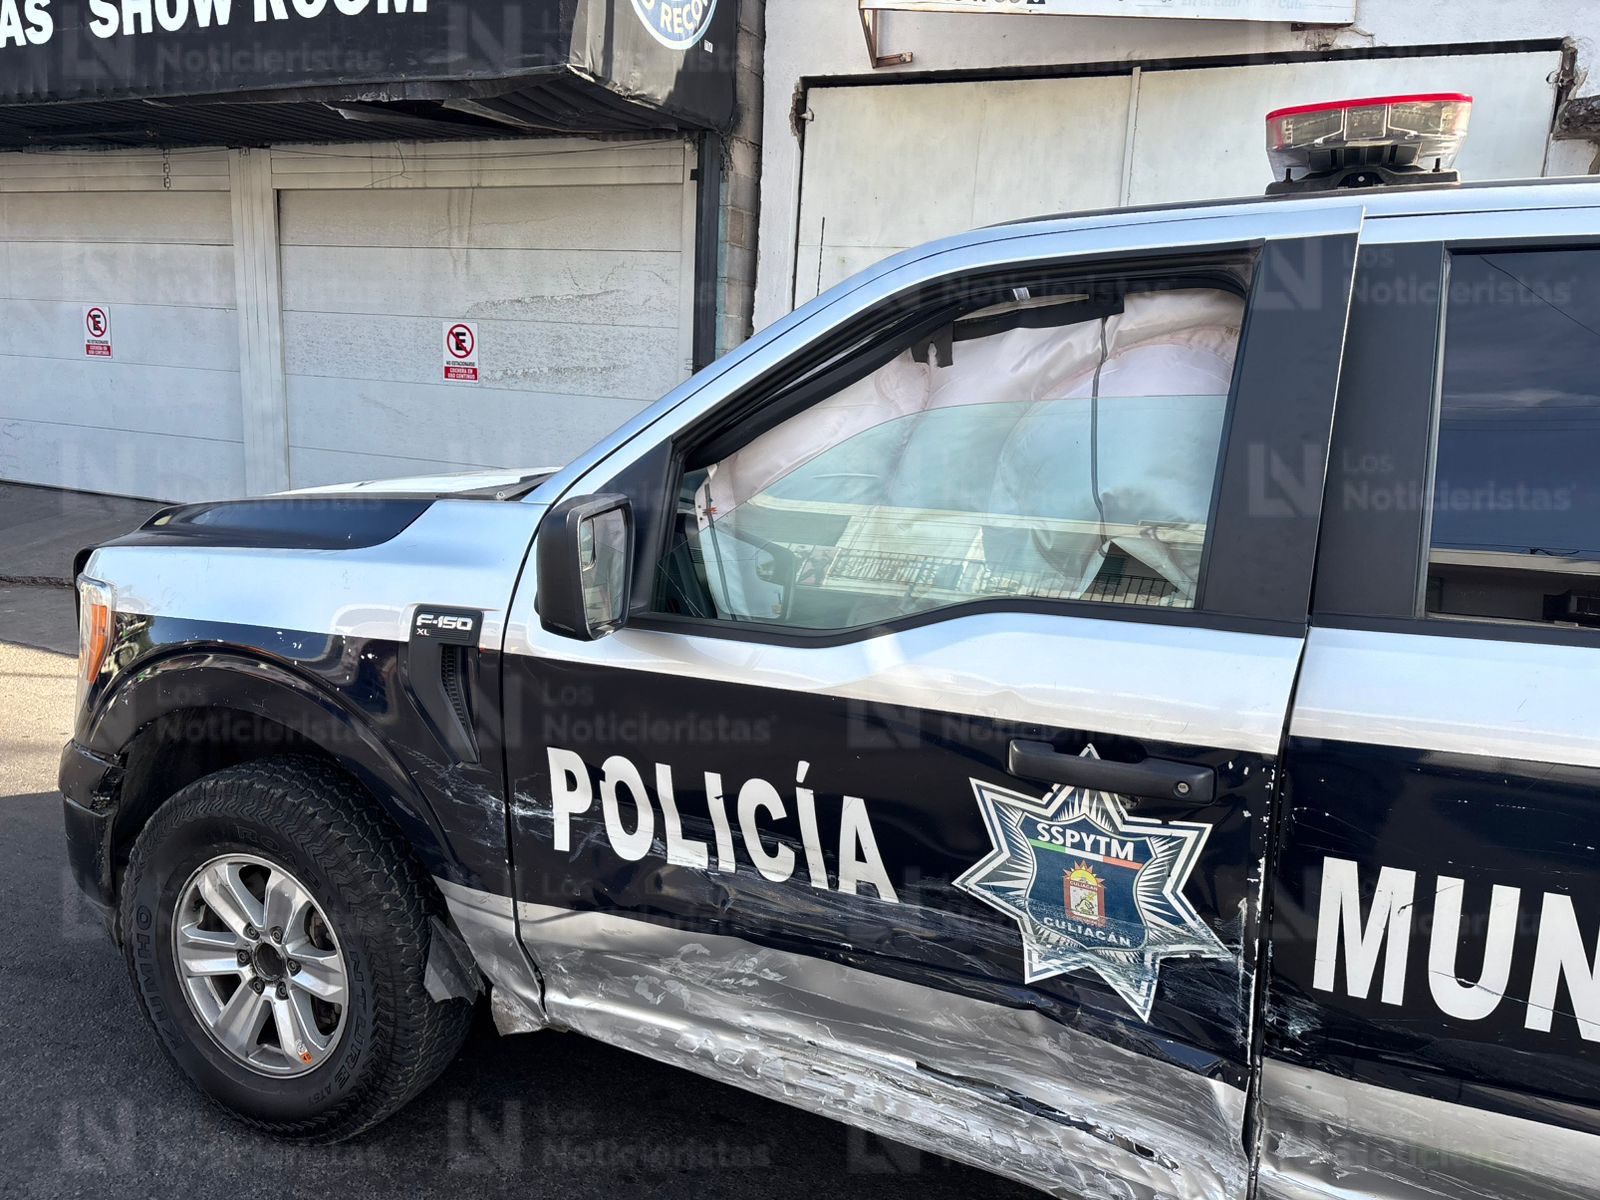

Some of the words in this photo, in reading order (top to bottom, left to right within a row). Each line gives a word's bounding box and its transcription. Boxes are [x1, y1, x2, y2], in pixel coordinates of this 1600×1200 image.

[416, 613, 473, 631] F-150
[416, 628, 430, 636] XL
[547, 746, 900, 904] POLICÍA
[1036, 822, 1135, 862] SSPYTM
[1313, 856, 1600, 1044] MUN
